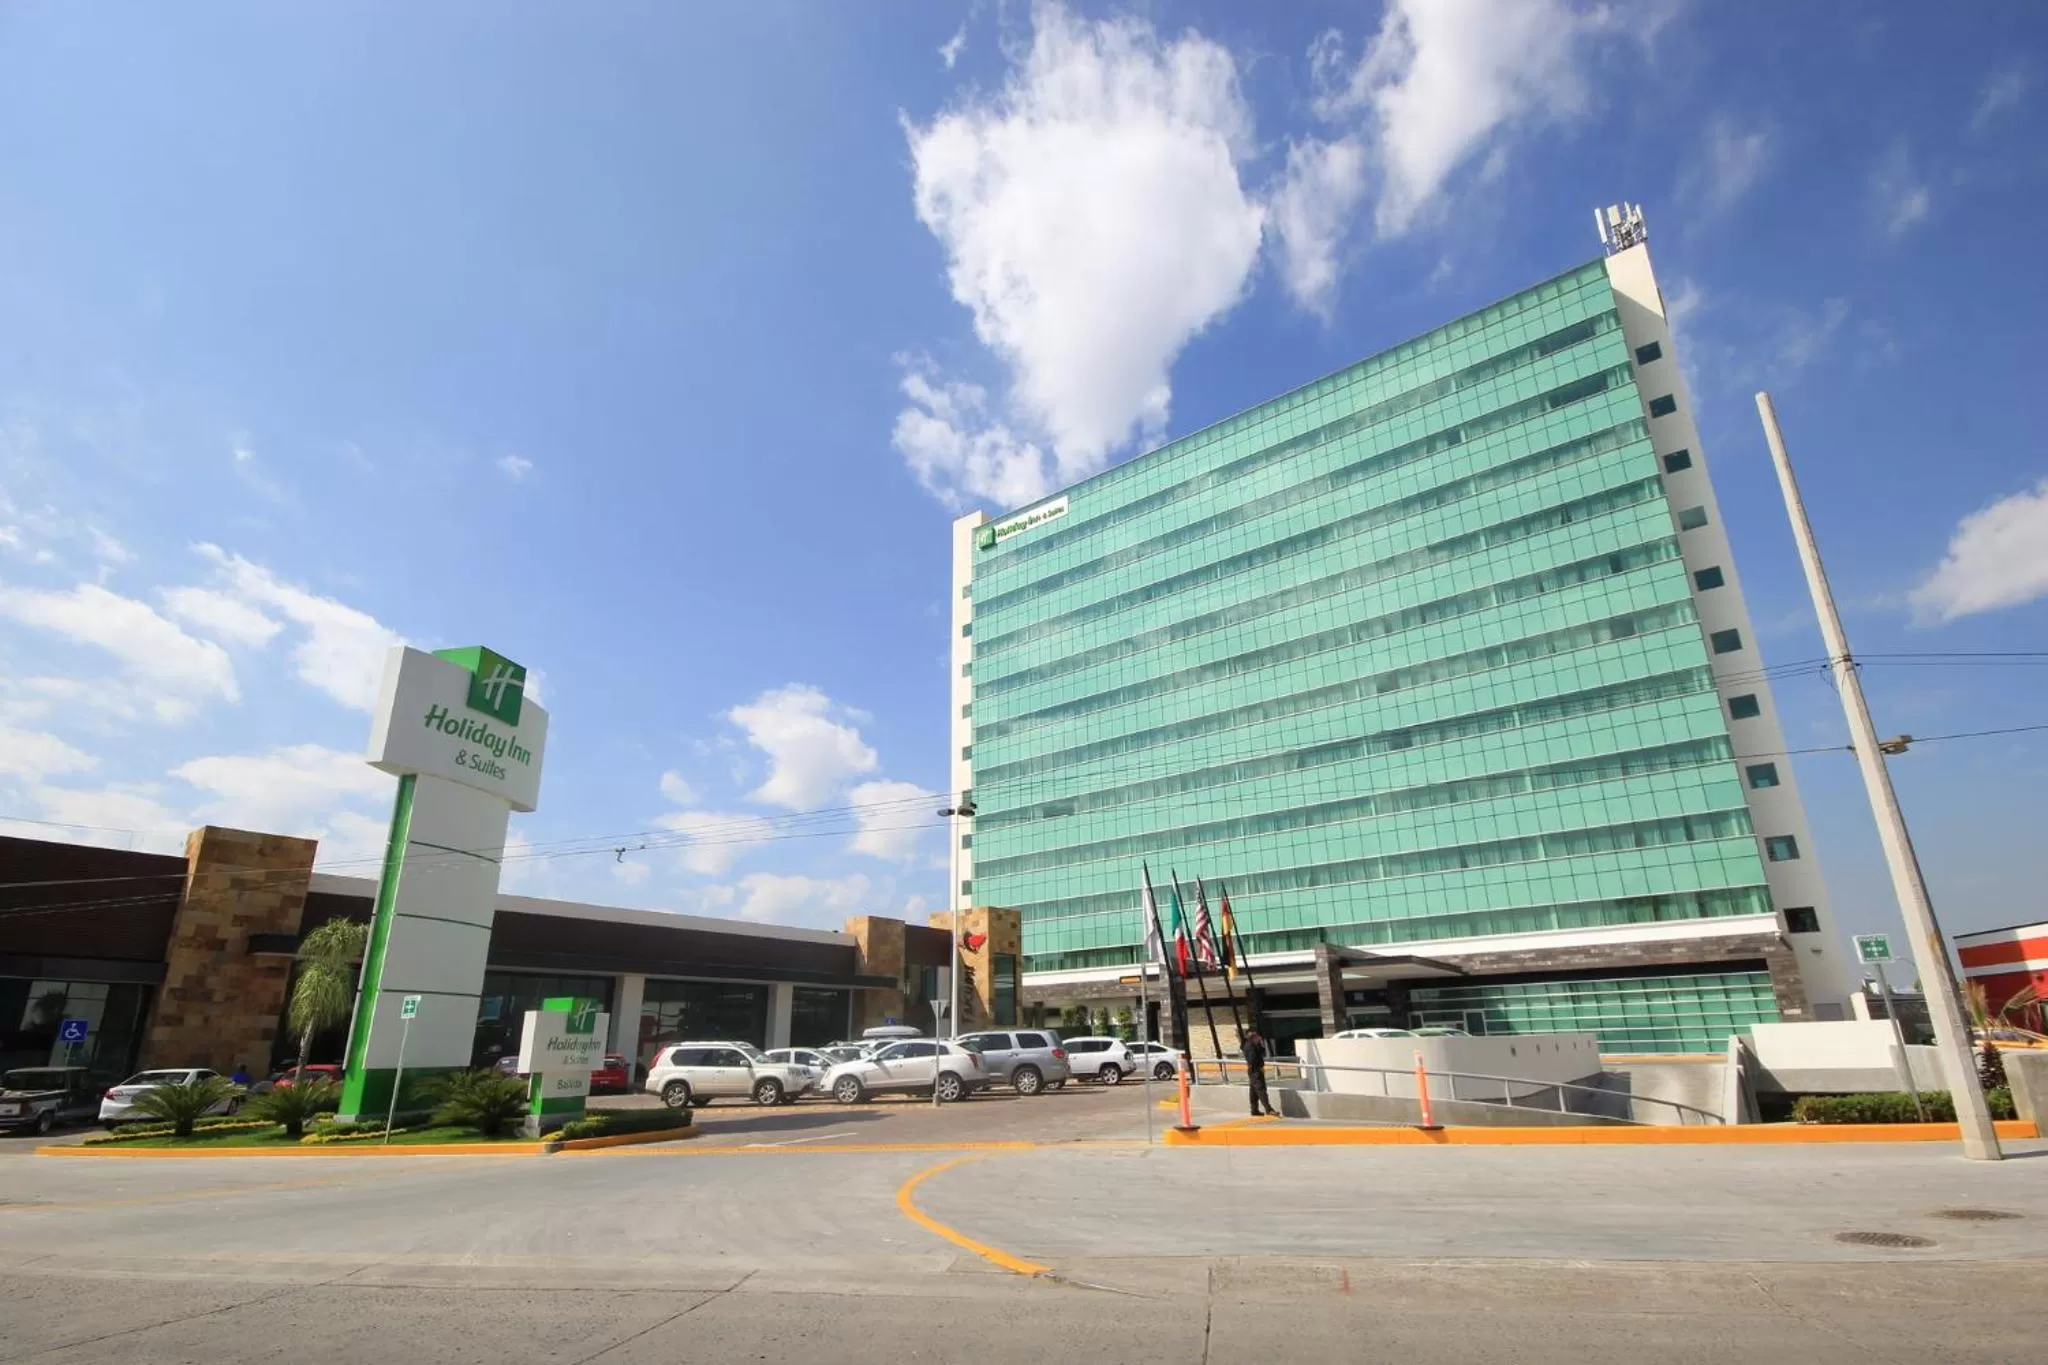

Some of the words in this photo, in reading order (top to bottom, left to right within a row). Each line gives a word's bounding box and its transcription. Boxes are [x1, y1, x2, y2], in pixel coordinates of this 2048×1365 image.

[424, 704, 507, 758] Holiday
[507, 735, 531, 767] Inn
[455, 749, 468, 766] &
[469, 753, 506, 781] Suites
[547, 1036, 588, 1053] Holiday
